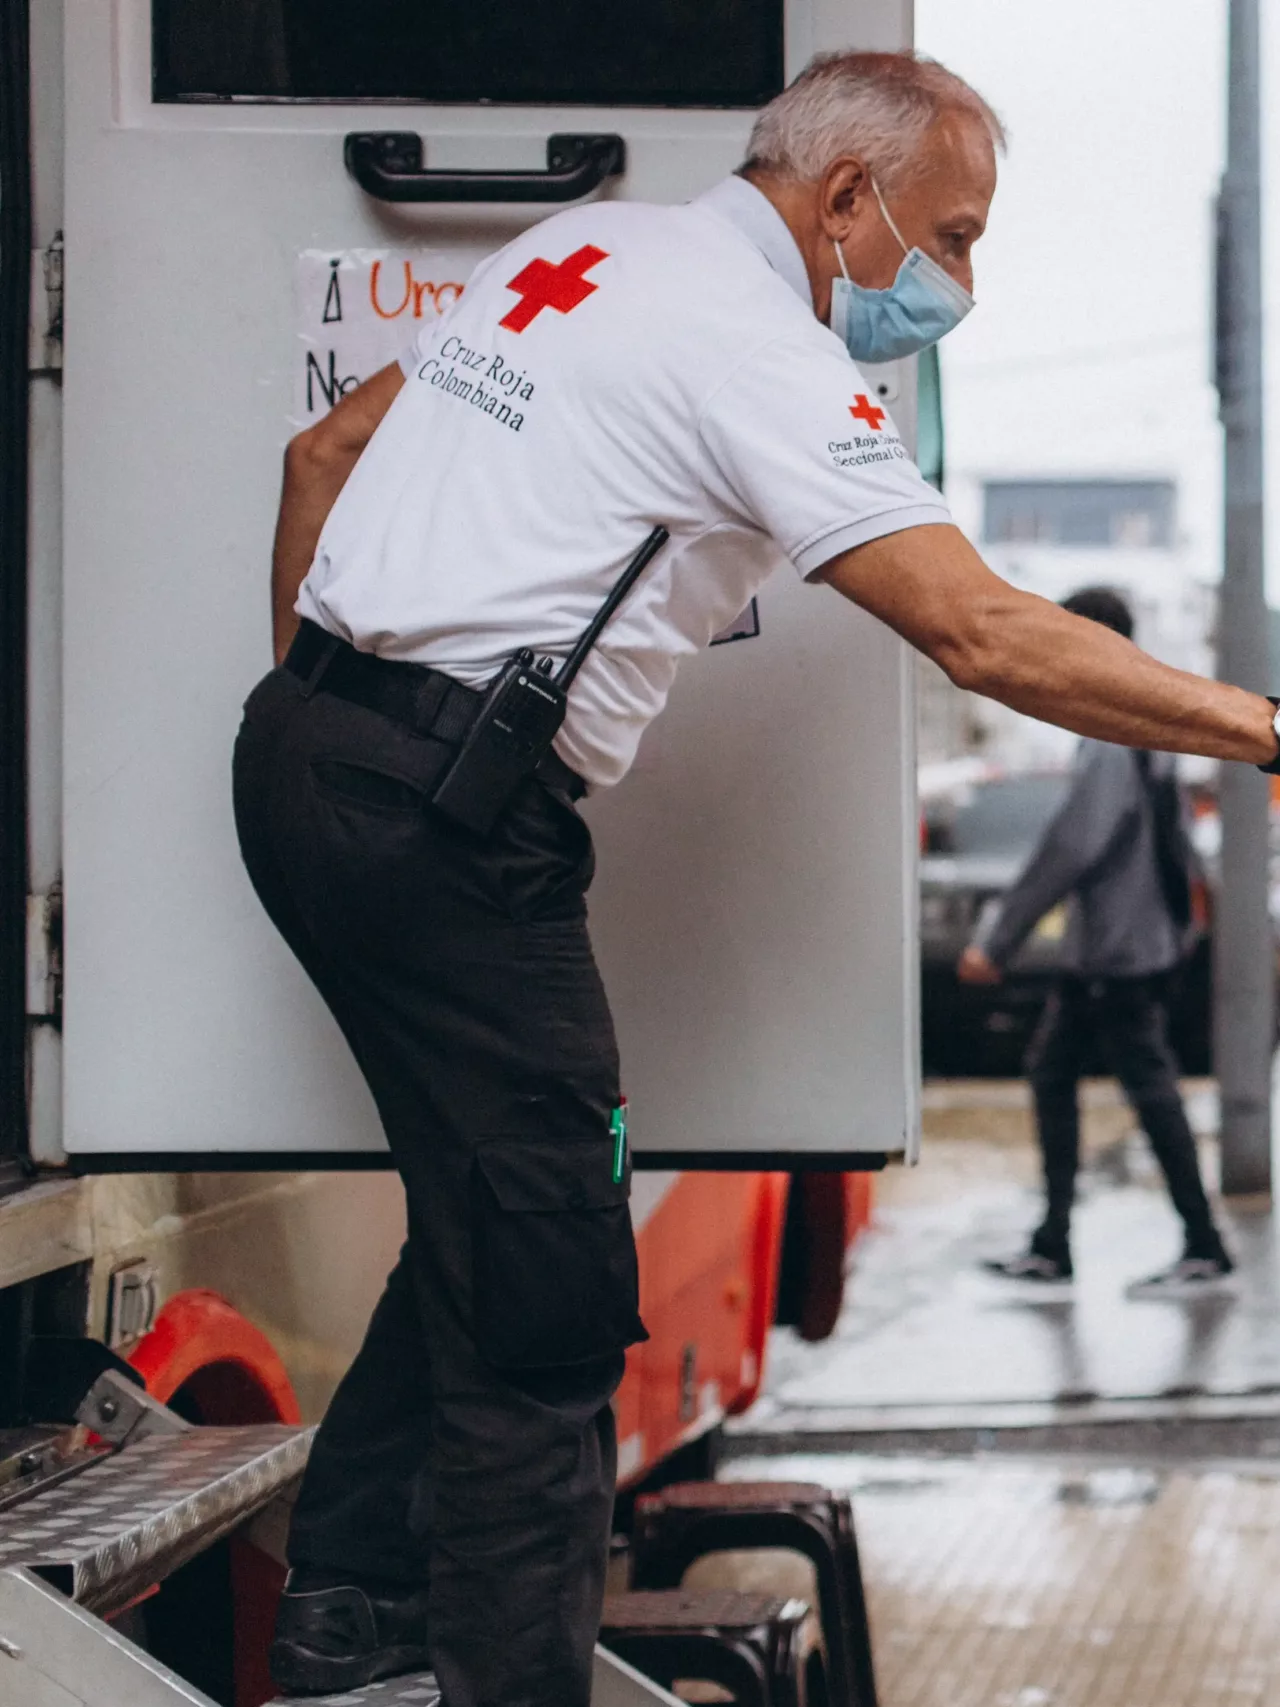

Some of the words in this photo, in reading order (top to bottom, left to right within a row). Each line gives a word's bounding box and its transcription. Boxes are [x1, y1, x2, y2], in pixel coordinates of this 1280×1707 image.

[440, 336, 486, 372] Cruz
[485, 354, 535, 402] Roja
[418, 359, 526, 432] Colombiana
[828, 440, 852, 454] Cruz
[854, 433, 879, 450] Roja
[833, 450, 893, 467] Seccional
